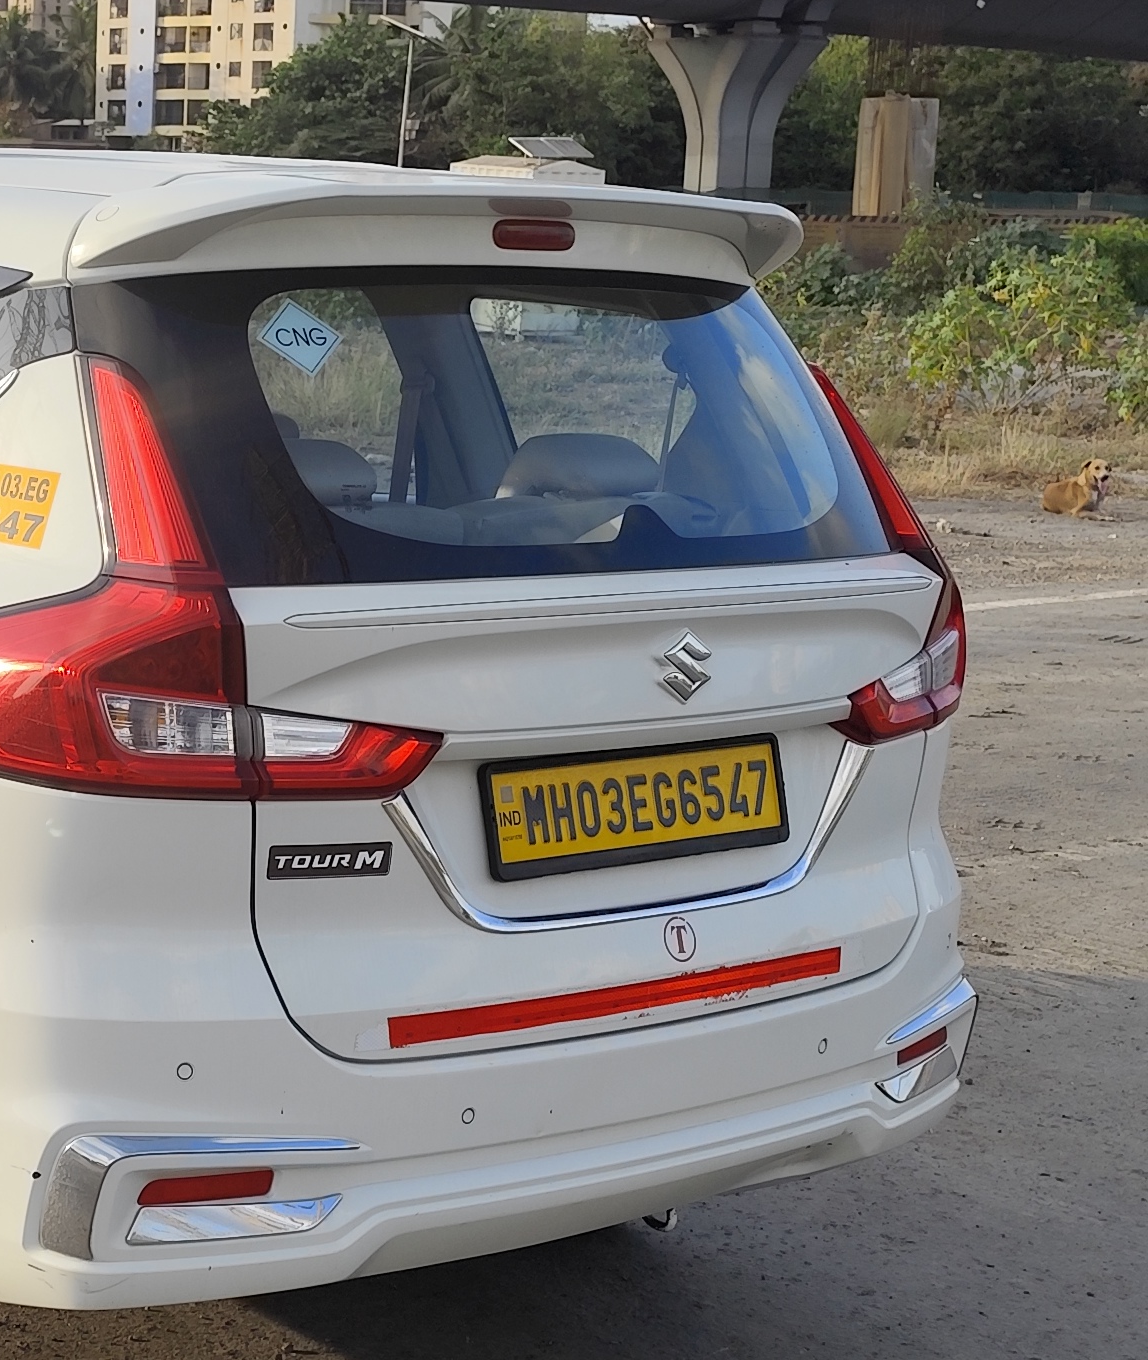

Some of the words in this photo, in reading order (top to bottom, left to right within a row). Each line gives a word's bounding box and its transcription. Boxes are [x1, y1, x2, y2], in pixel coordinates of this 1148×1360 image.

[275, 327, 327, 347] CNG
[521, 759, 767, 846] MH03EG6547
[498, 810, 521, 828] IND
[670, 925, 688, 954] T
